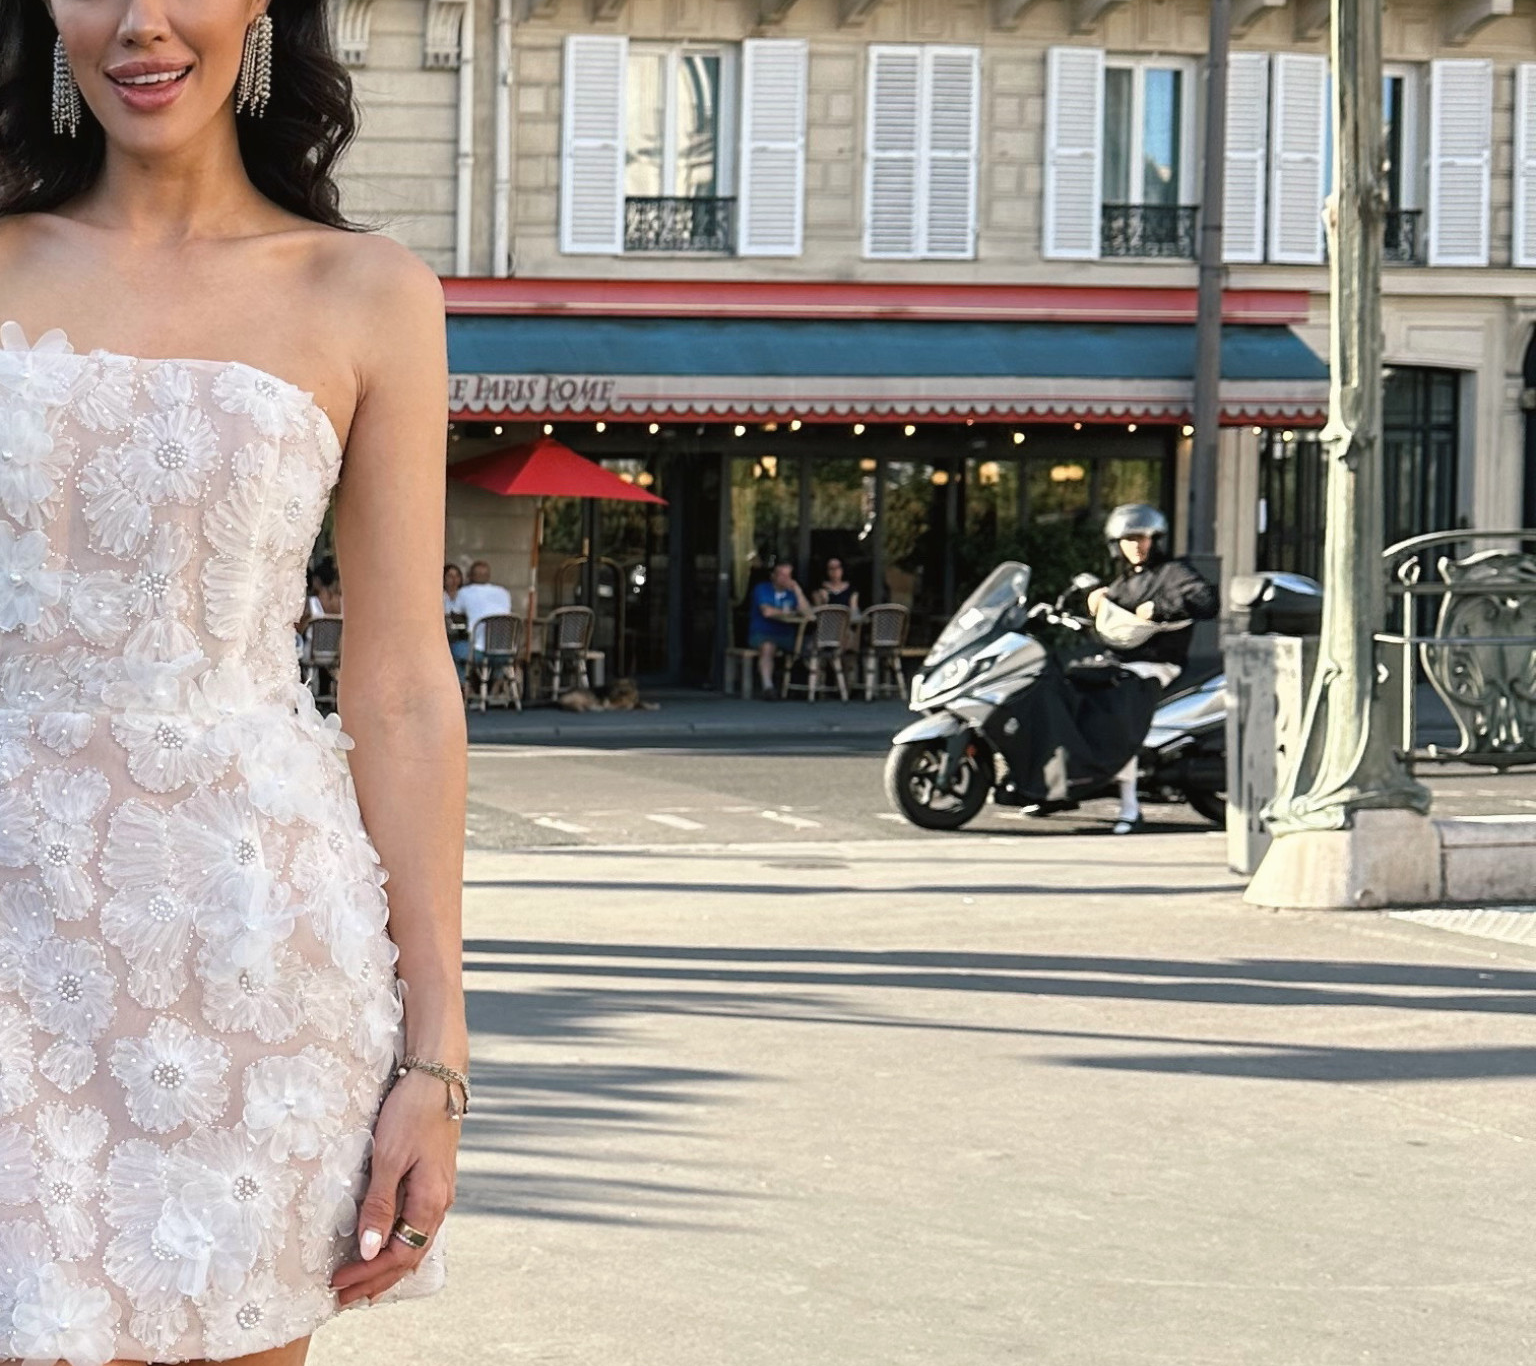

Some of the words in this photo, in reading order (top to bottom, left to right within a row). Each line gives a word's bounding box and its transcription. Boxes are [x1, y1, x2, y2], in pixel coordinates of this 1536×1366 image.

[449, 378, 468, 401] E
[473, 375, 540, 402] PARIS
[544, 374, 616, 403] ROME
